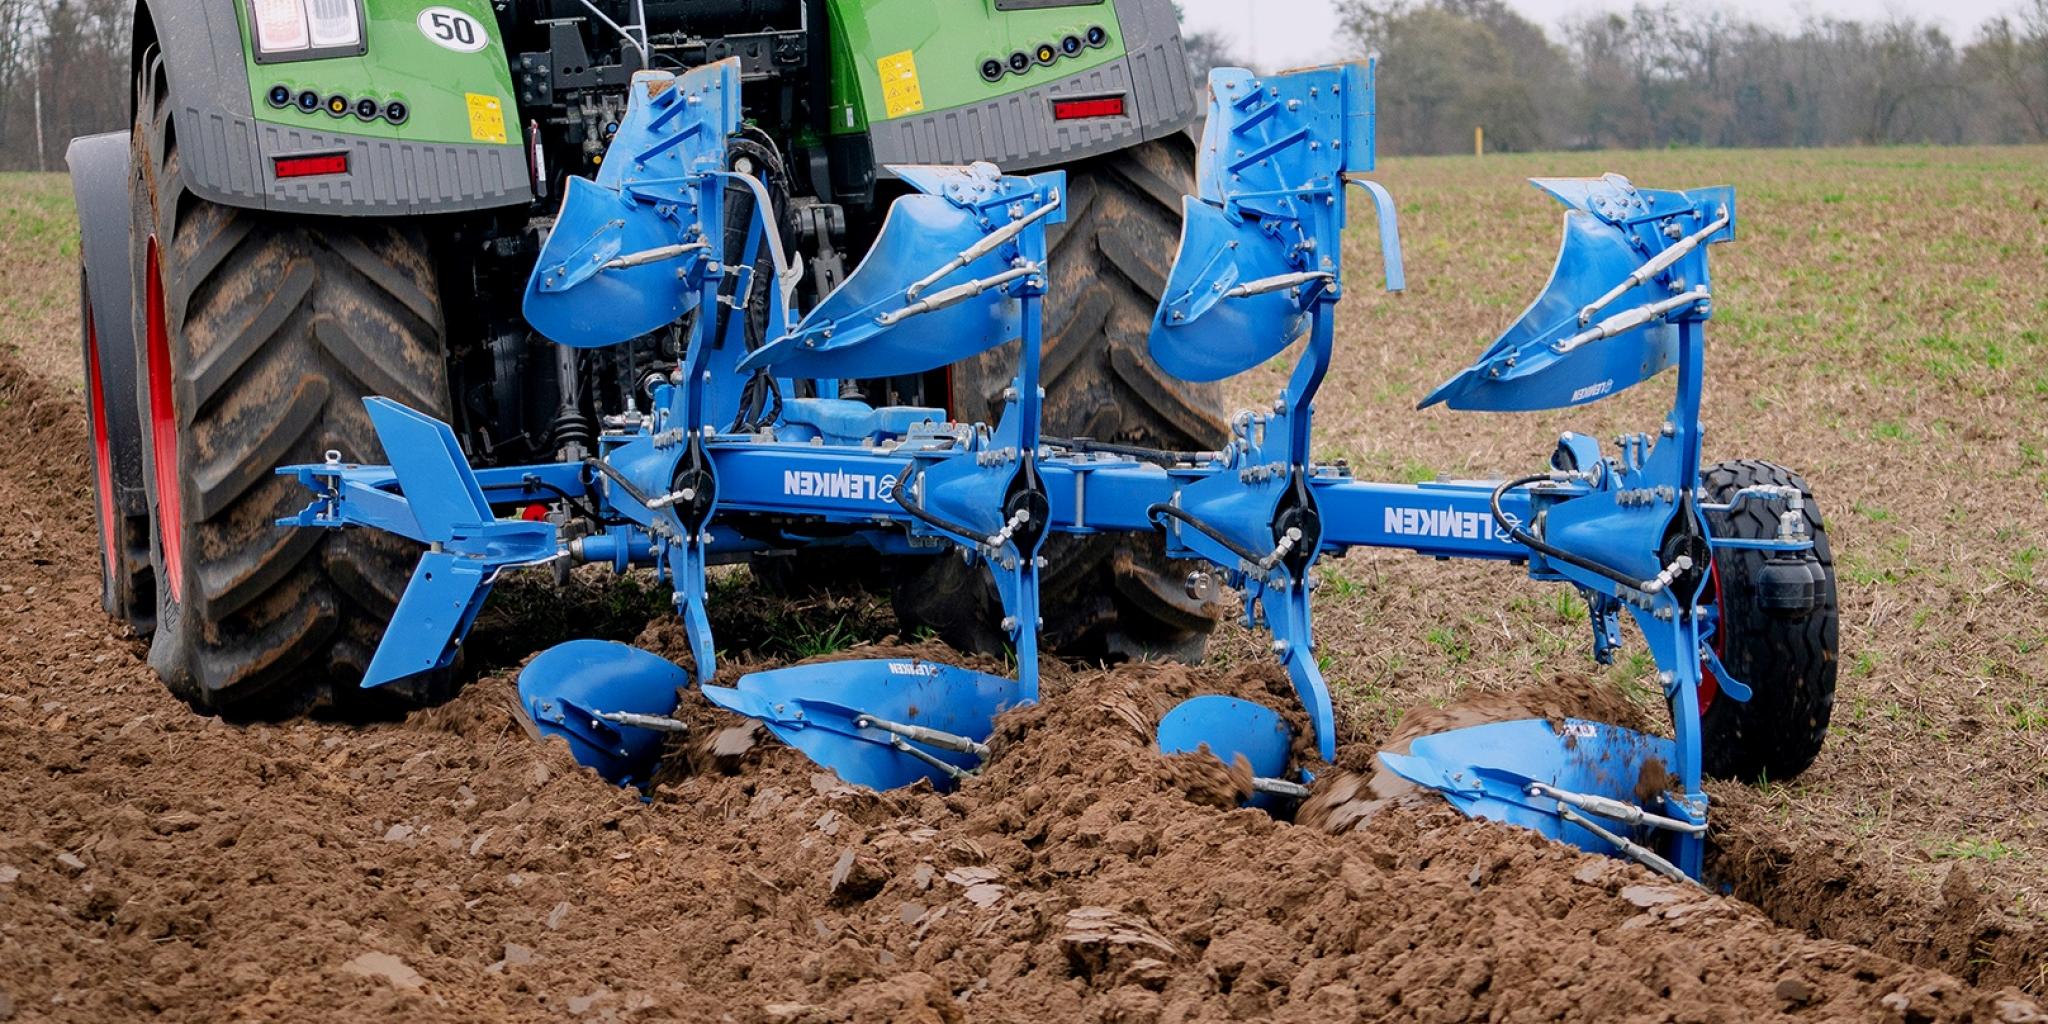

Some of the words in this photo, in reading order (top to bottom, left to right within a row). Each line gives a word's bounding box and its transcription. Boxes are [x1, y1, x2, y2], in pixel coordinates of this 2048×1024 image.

[431, 13, 474, 44] 50
[784, 468, 876, 500] LEMKEN
[1385, 504, 1492, 540] LEMKEN
